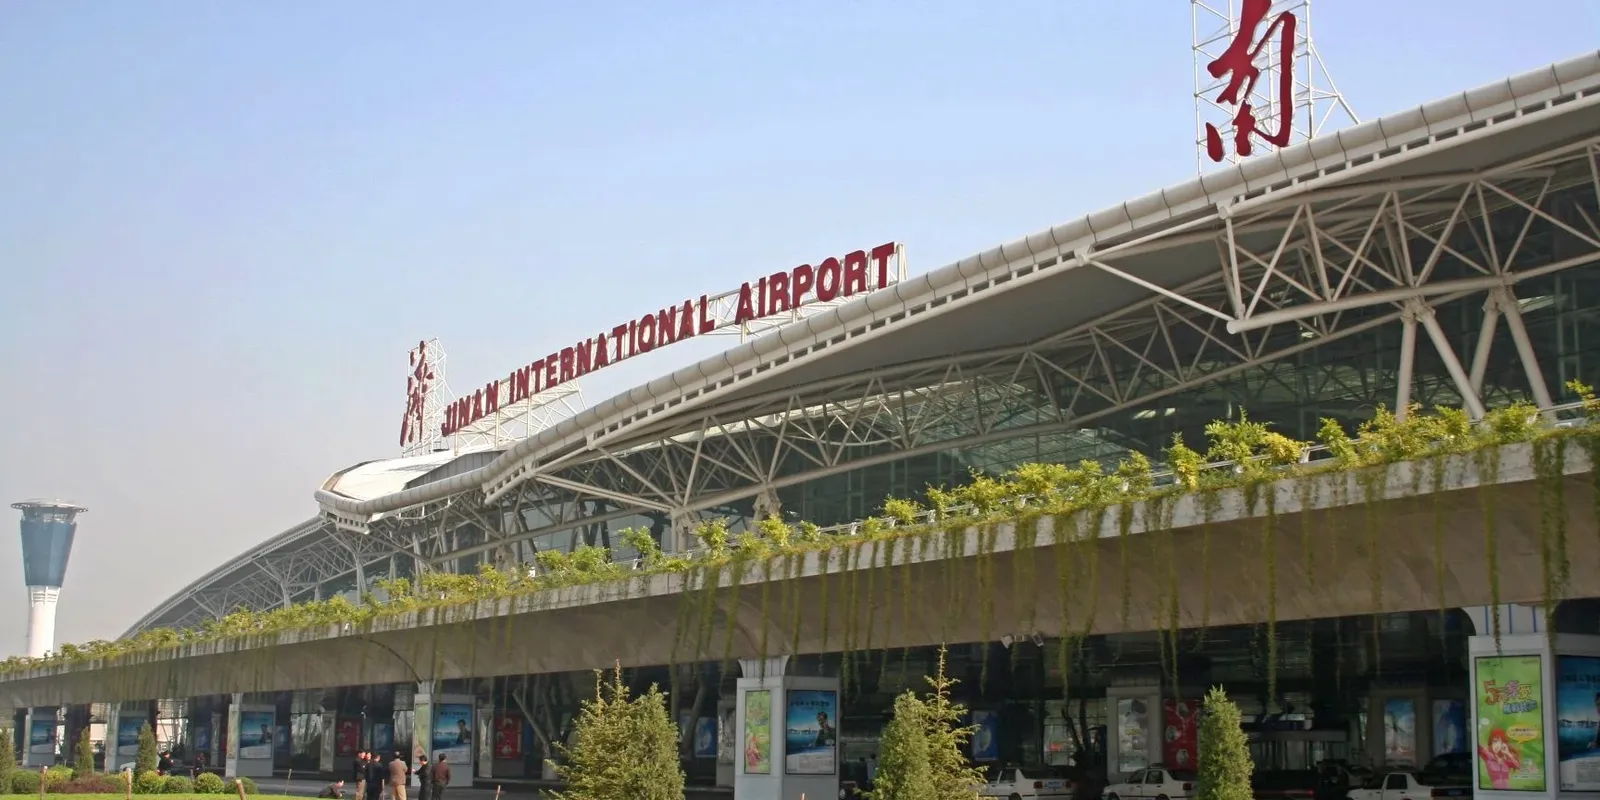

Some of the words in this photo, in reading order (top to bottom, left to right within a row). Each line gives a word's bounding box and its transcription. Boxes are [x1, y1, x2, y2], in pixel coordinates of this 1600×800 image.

[441, 380, 499, 436] JINAN
[509, 296, 715, 404] INTERNATIONAL
[735, 241, 896, 325] AIRPORT
